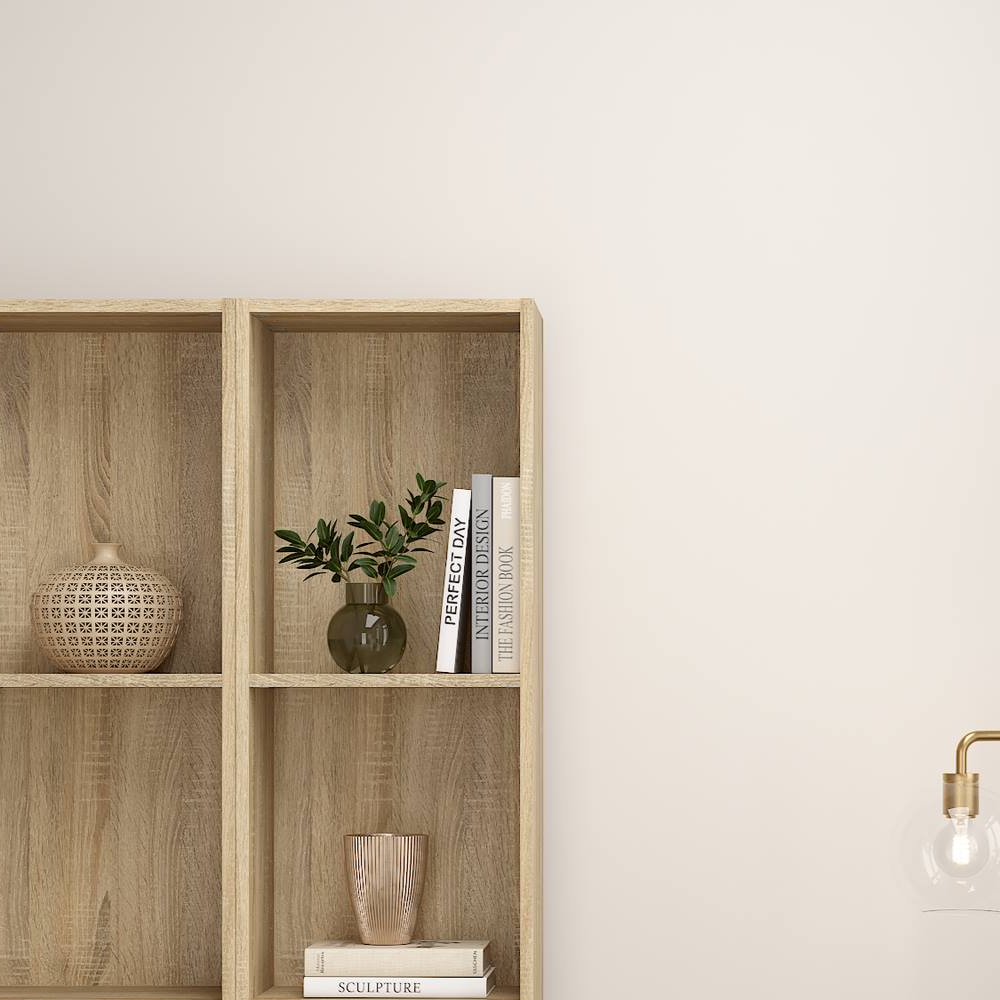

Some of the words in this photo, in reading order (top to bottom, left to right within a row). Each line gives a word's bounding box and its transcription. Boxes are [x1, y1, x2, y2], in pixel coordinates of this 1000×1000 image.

[452, 518, 466, 548] DAY
[476, 509, 489, 564] DESIGN
[498, 546, 513, 580] BOOK
[445, 553, 463, 625] PERFECT
[476, 570, 489, 640] INTERIOR
[498, 584, 513, 634] FASHION
[498, 638, 513, 661] THE
[338, 981, 421, 994] SCULPTURE
